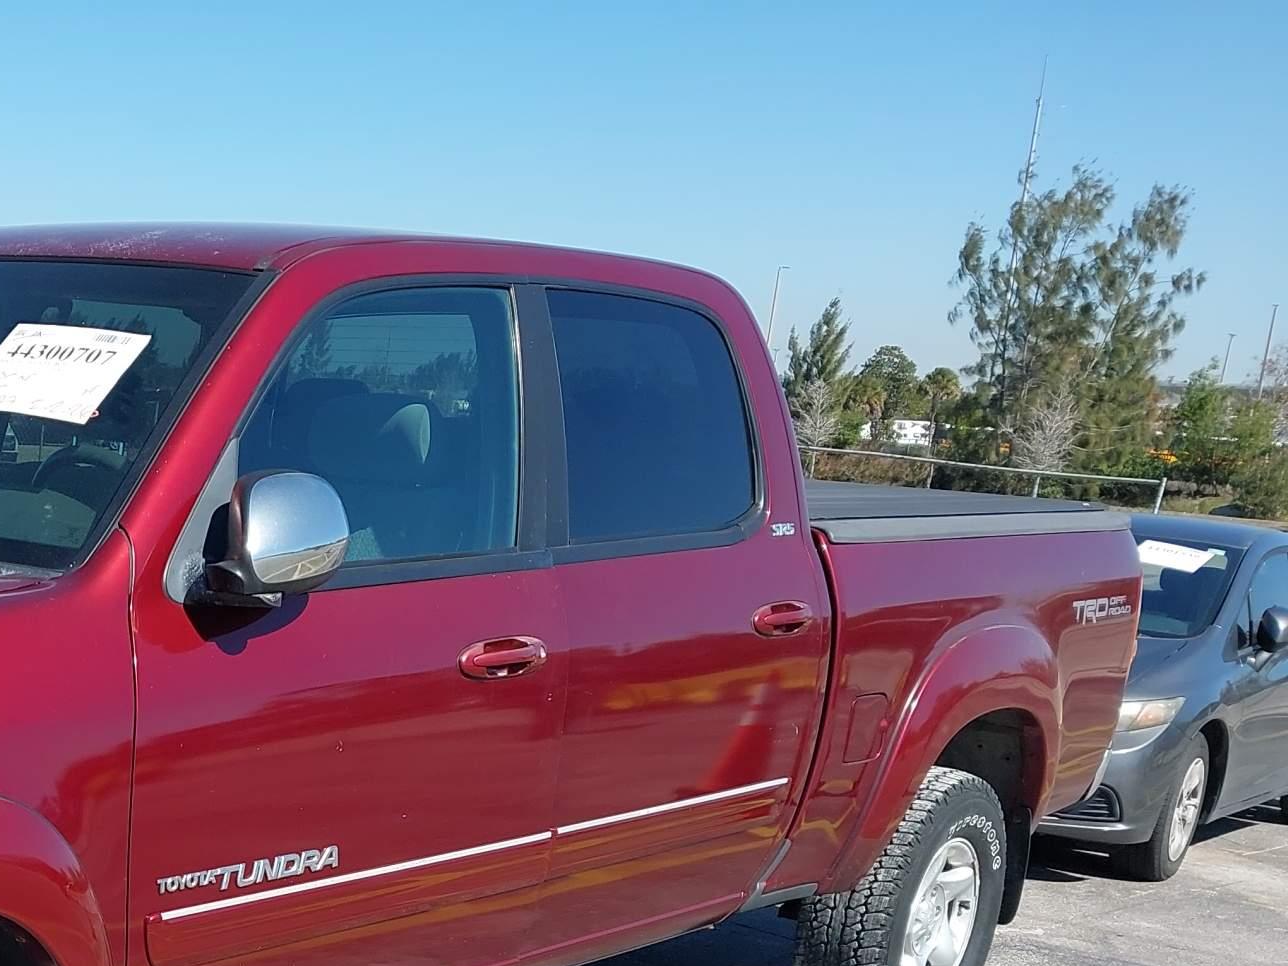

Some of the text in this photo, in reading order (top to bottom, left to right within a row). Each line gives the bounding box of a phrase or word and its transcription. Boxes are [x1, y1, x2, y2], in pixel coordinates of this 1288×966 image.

[7, 343, 117, 365] 44300707
[1072, 597, 1109, 625] TRD
[1108, 605, 1132, 616] ROAD
[1109, 595, 1127, 605] OFF
[157, 845, 339, 894] TOYOTA TUNDRA
